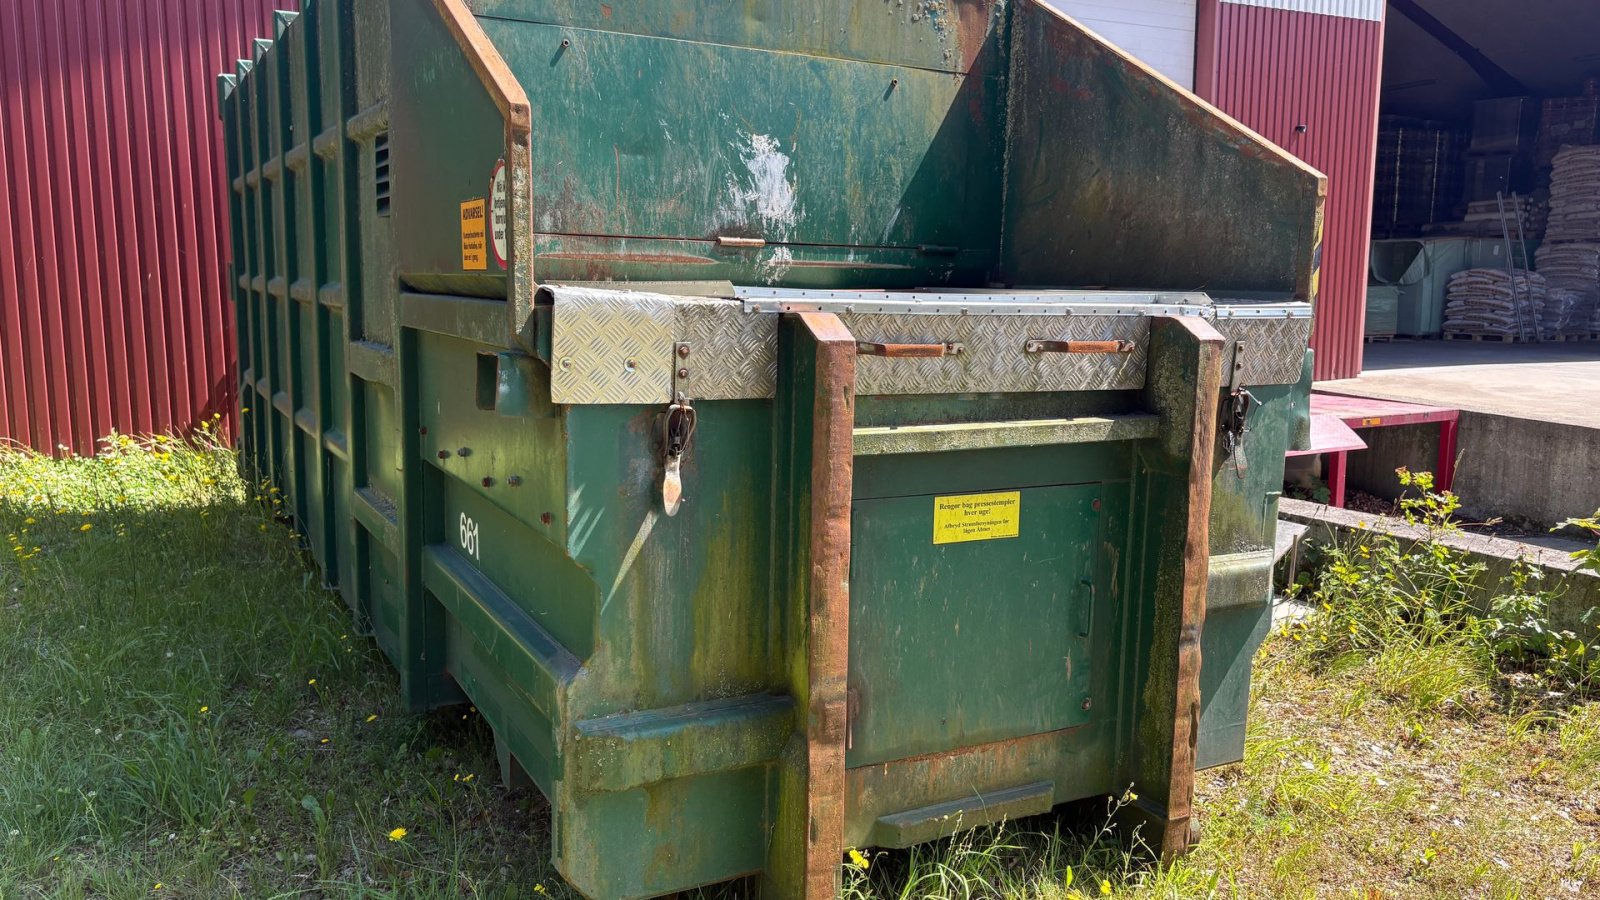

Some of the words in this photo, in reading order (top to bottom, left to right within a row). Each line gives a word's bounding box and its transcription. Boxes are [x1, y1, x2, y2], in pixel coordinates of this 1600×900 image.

[463, 205, 484, 220] ADVARSEL!
[939, 503, 960, 511] Rengør
[974, 499, 1016, 509] pressestempler
[979, 508, 991, 516] uge!
[460, 511, 479, 560] 661
